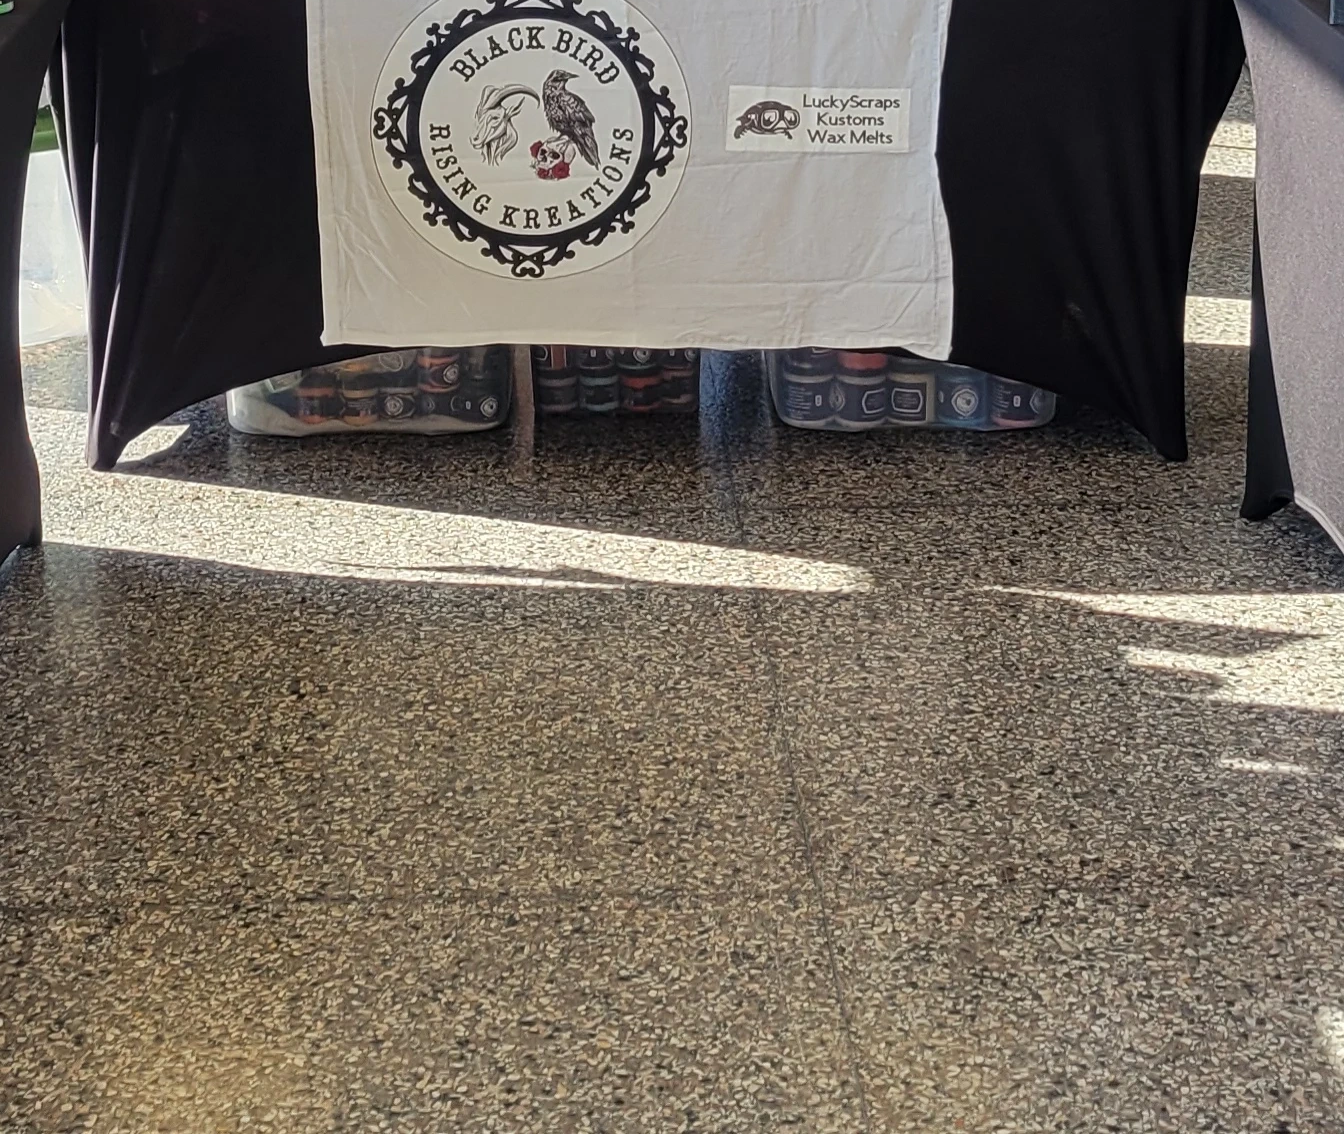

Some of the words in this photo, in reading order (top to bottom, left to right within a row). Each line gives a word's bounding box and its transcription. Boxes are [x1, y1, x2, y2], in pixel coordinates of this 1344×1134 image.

[449, 26, 546, 84] BLACK
[552, 28, 620, 87] BIRD
[803, 94, 900, 112] LuckyScraps
[817, 113, 884, 126] Kustoms
[807, 129, 846, 144] Wax
[850, 130, 893, 144] Melts
[429, 122, 492, 217] RISING
[498, 127, 635, 229] KREATIONS
